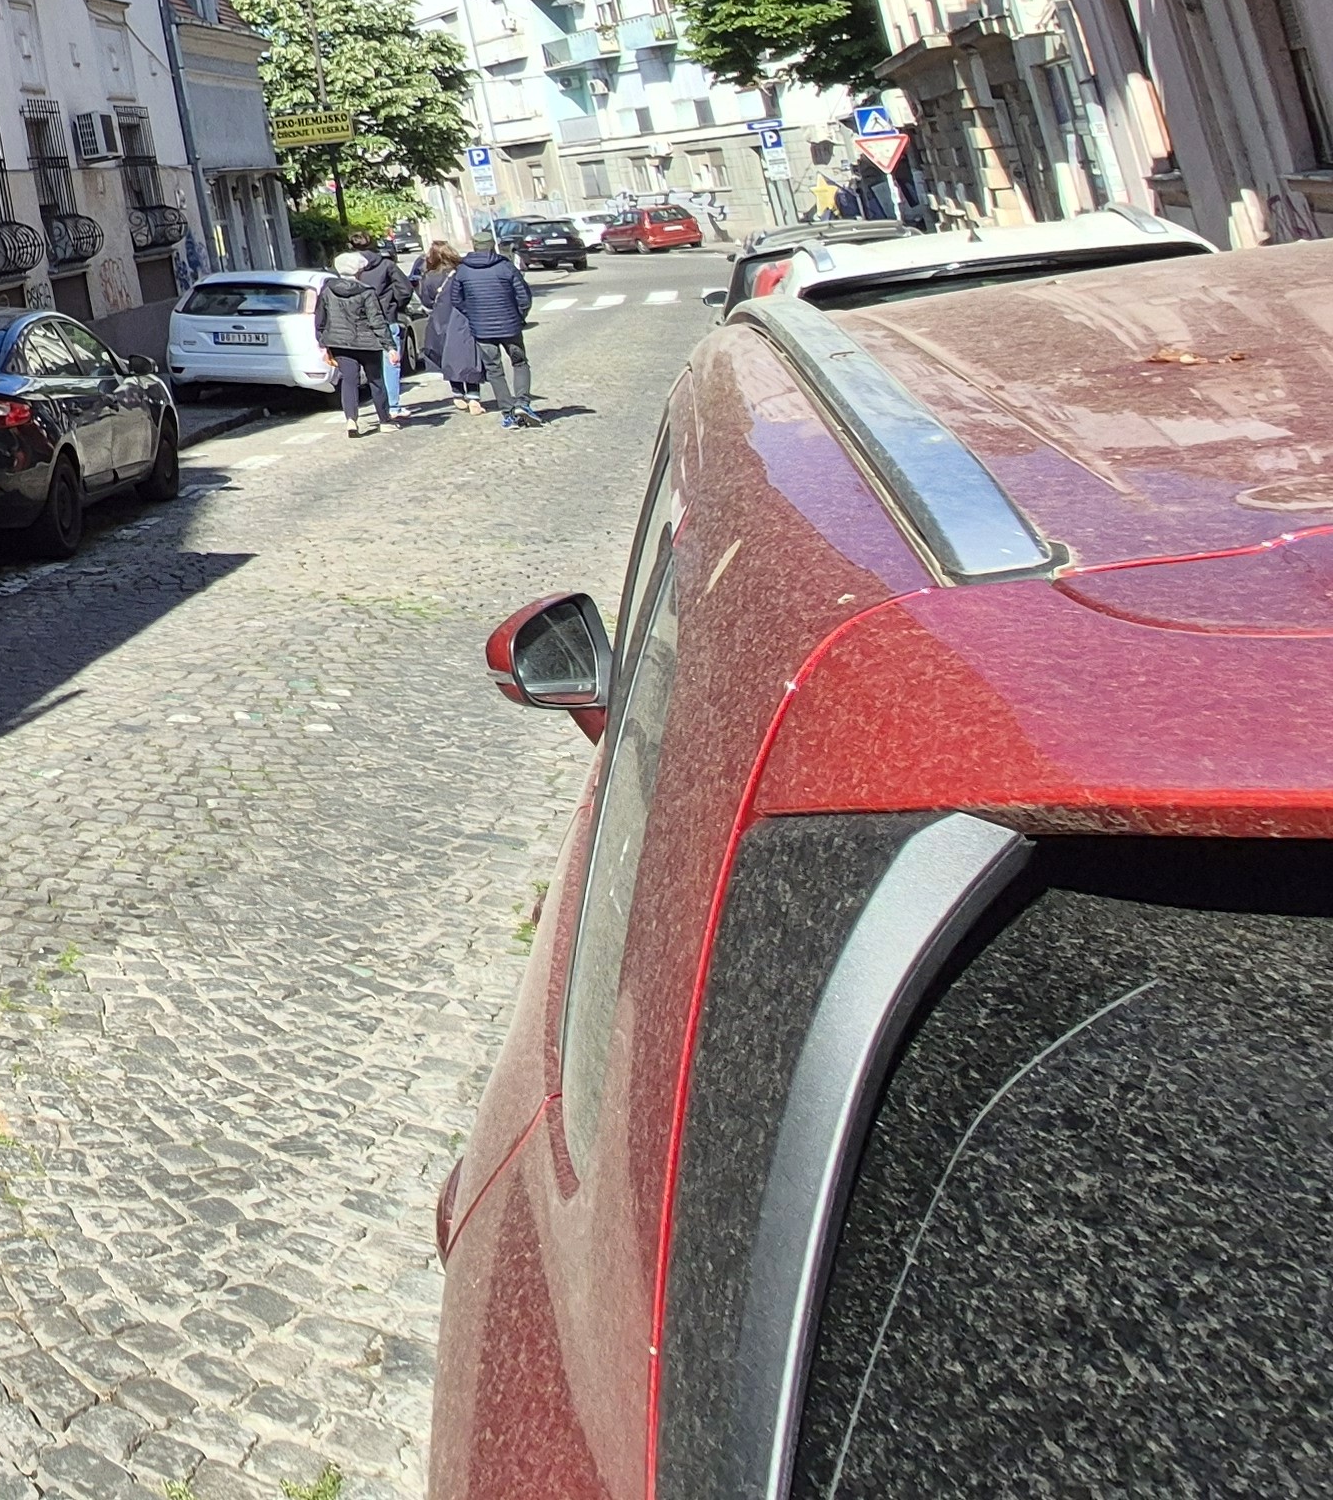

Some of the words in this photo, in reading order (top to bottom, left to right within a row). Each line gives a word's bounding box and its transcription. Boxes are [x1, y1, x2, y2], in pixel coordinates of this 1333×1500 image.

[276, 113, 348, 129] EKO-HEMIJSKO
[764, 131, 778, 148] P
[471, 150, 485, 165] P
